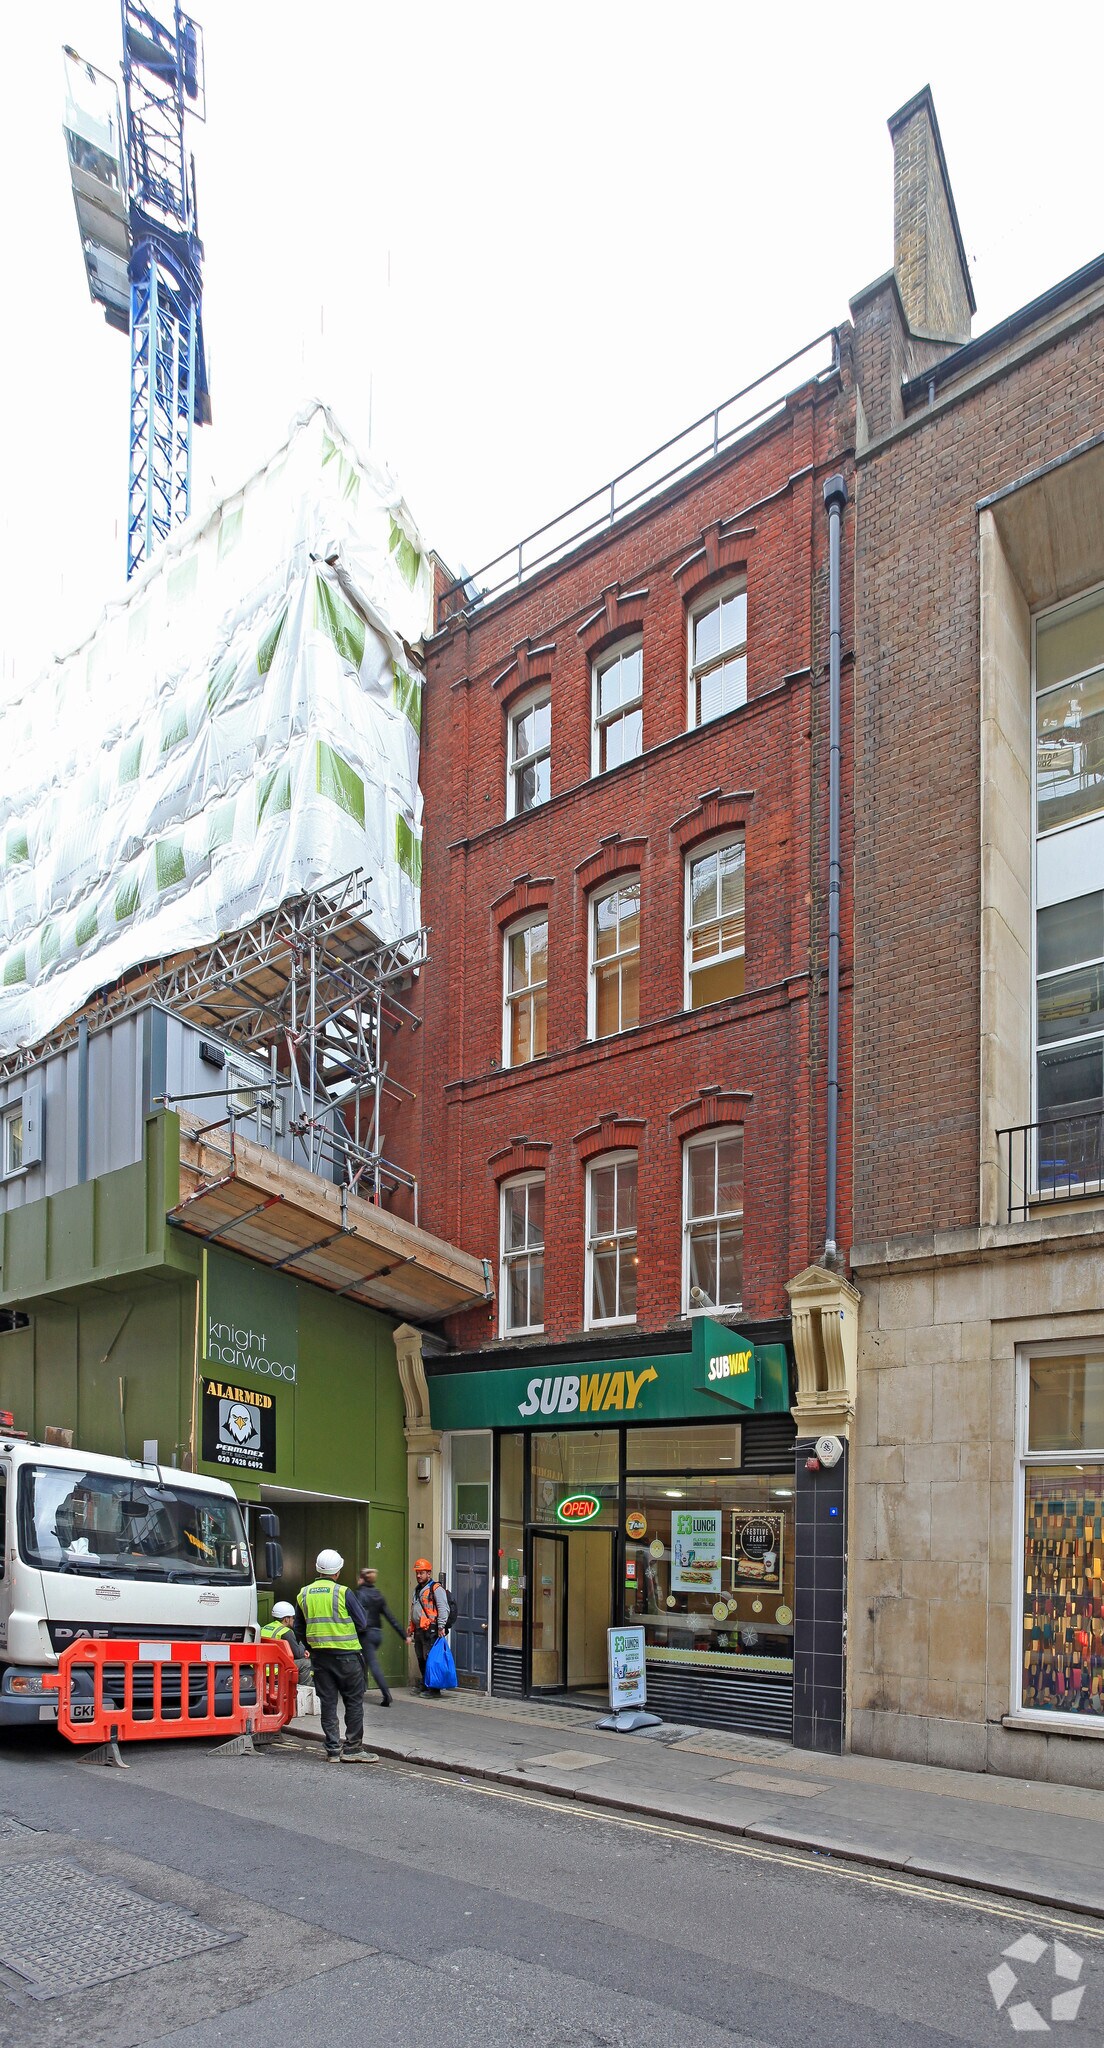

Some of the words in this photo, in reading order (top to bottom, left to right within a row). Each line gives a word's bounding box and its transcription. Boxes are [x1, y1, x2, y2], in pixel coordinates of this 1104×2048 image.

[208, 1316, 267, 1352] knight
[208, 1338, 296, 1382] harwood
[708, 1350, 752, 1381] SUBWAY
[206, 1381, 273, 1409] ALARMED
[517, 1365, 658, 1418] SUBWAY
[215, 1443, 265, 1457] PERMANEX
[217, 1455, 230, 1463] 020
[231, 1457, 247, 1466] 7428
[247, 1459, 263, 1469] 6492
[562, 1501, 594, 1517] OPEN
[676, 1514, 693, 1535] £3
[693, 1520, 716, 1531] LUNCH
[746, 1528, 769, 1536] FESTIVE
[749, 1535, 766, 1543] FEAST
[54, 1628, 109, 1638] DAF
[220, 1632, 243, 1641] LF
[614, 1635, 625, 1653] £3
